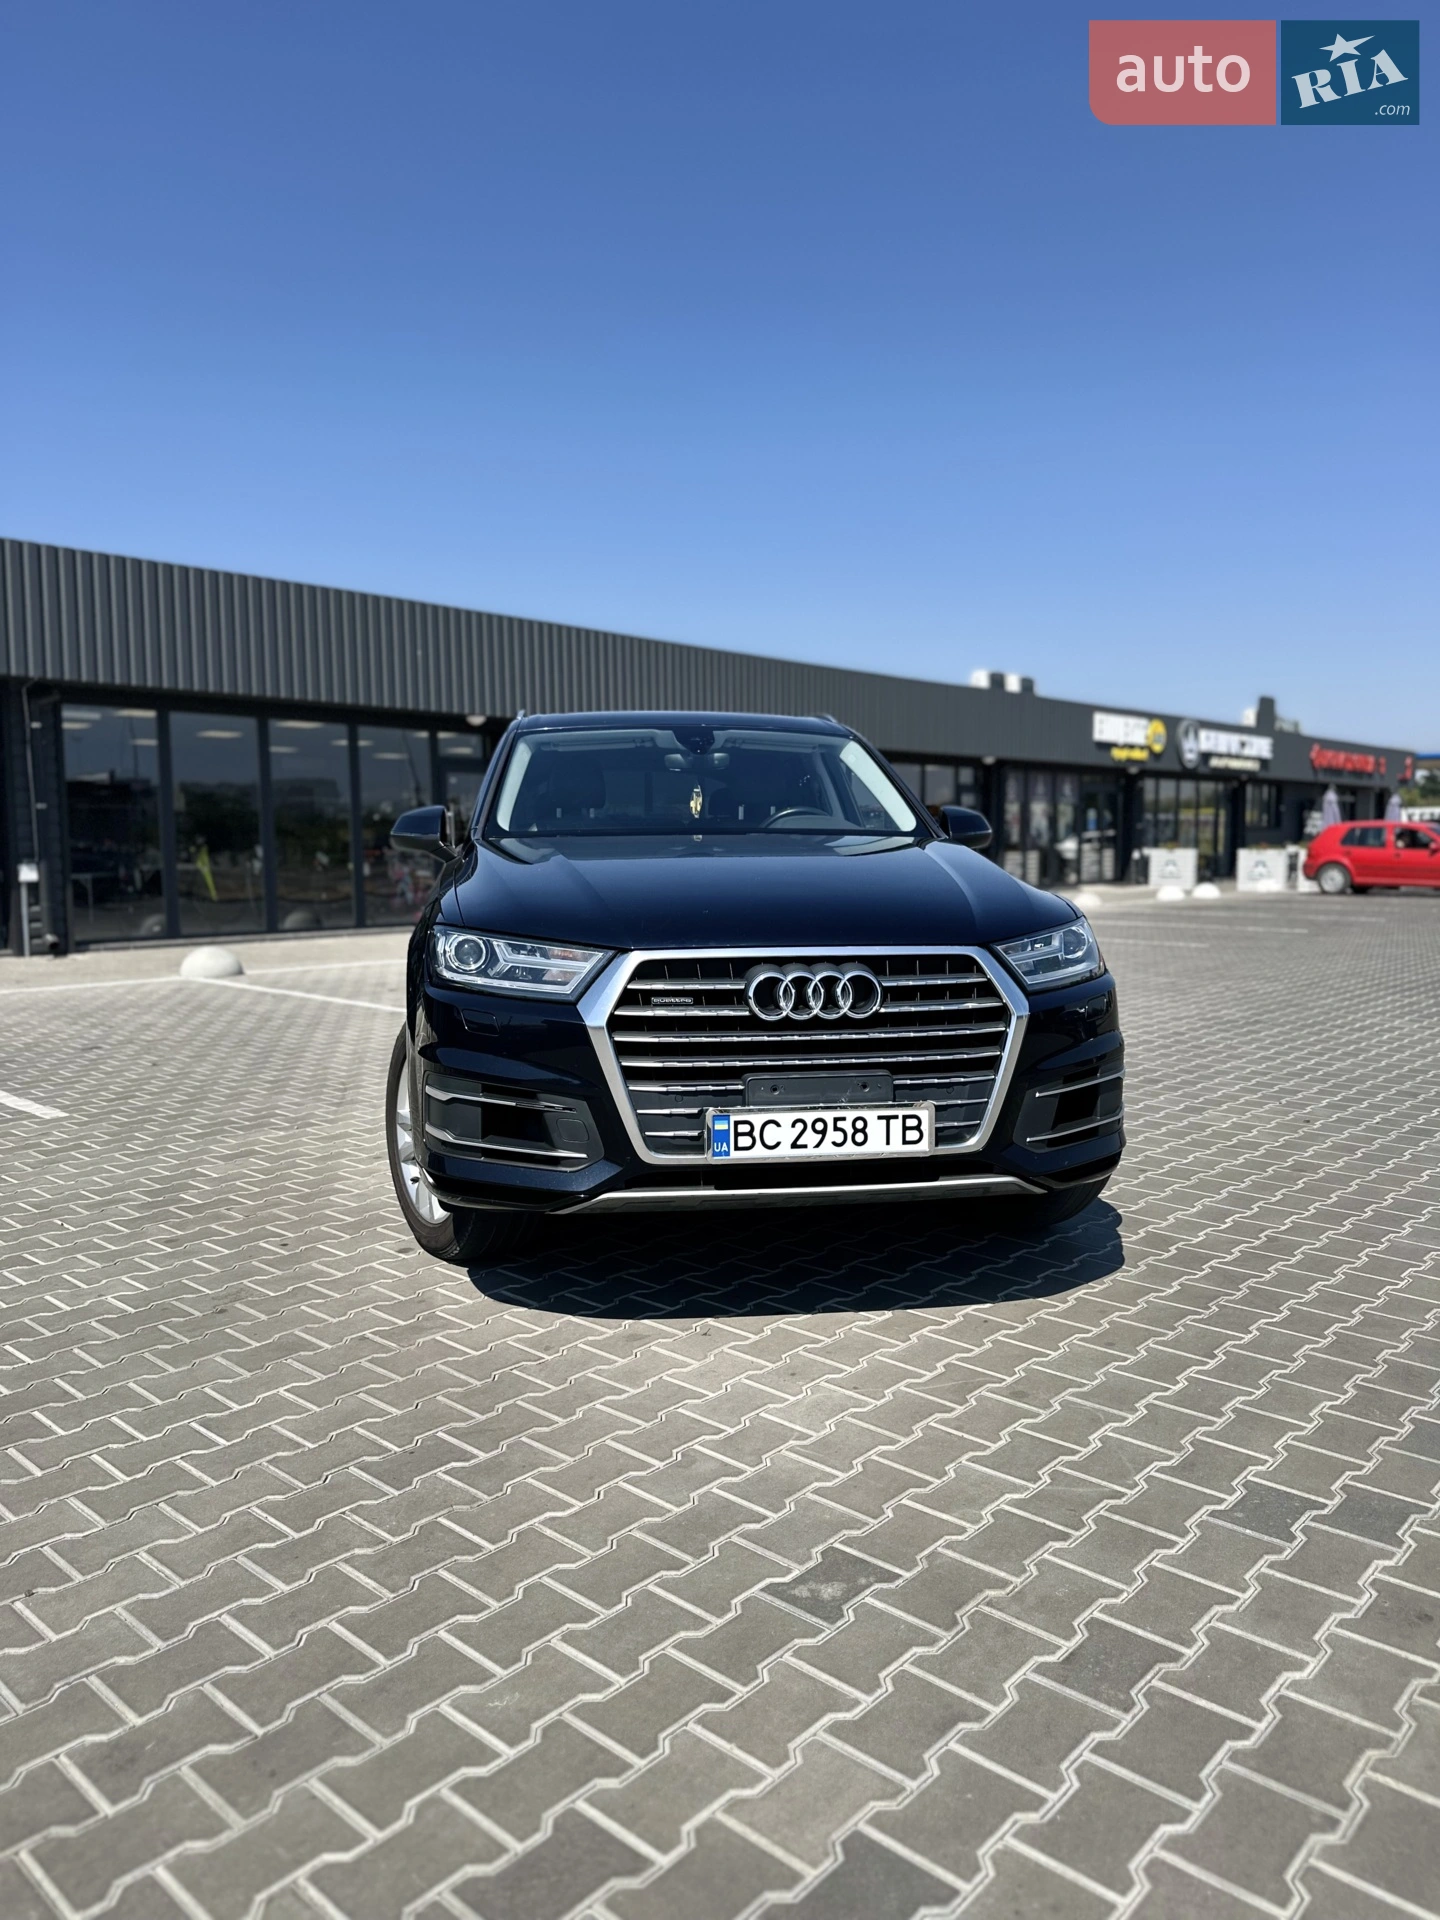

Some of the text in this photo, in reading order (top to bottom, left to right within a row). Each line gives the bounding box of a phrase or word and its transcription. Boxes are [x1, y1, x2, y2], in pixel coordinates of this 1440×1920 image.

[733, 1114, 924, 1152] BC 2958 TB
[714, 1142, 729, 1153] UA
